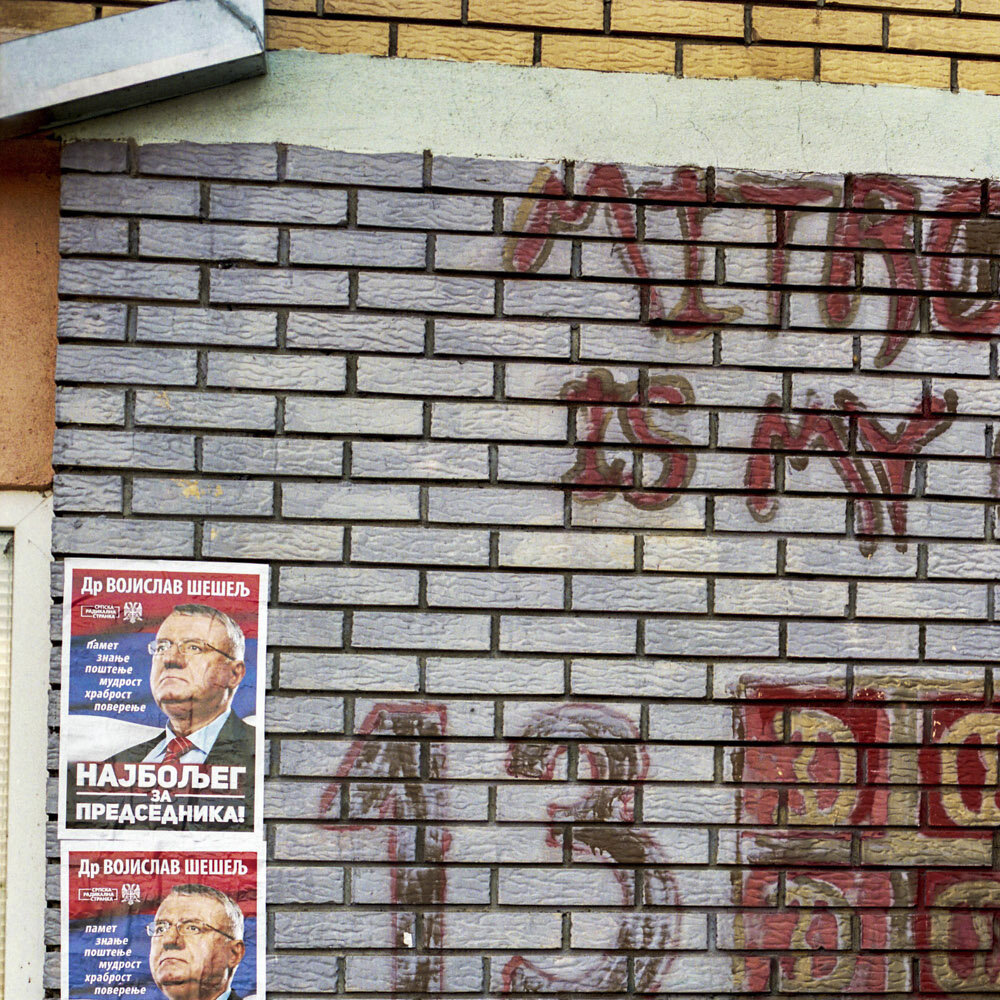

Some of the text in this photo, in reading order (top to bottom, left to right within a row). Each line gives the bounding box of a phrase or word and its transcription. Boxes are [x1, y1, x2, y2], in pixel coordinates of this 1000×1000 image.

[561, 365, 699, 512] IS
[745, 372, 959, 560] MY
[81, 576, 251, 598] Др ВОЈИСЛАВ ШЕШЕЉ
[86, 640, 119, 651] памет
[96, 653, 131, 663] знање
[85, 663, 133, 675] поштење
[98, 676, 142, 687] мудрост
[84, 688, 132, 700] храброст
[94, 701, 147, 713] поверење
[75, 763, 247, 790] НАЈБОЉЕГ
[150, 789, 172, 803] ЗА
[75, 803, 246, 824] ПРЕДСЕДНИКА!
[78, 858, 248, 878] Др ВОЈИСЛАВ ШЕШЕЉ
[85, 924, 117, 934] памет
[95, 936, 129, 946] знање
[84, 947, 132, 957] поштење
[98, 959, 141, 971] мудрост
[84, 972, 132, 983] храброст
[94, 985, 147, 996] поверење
